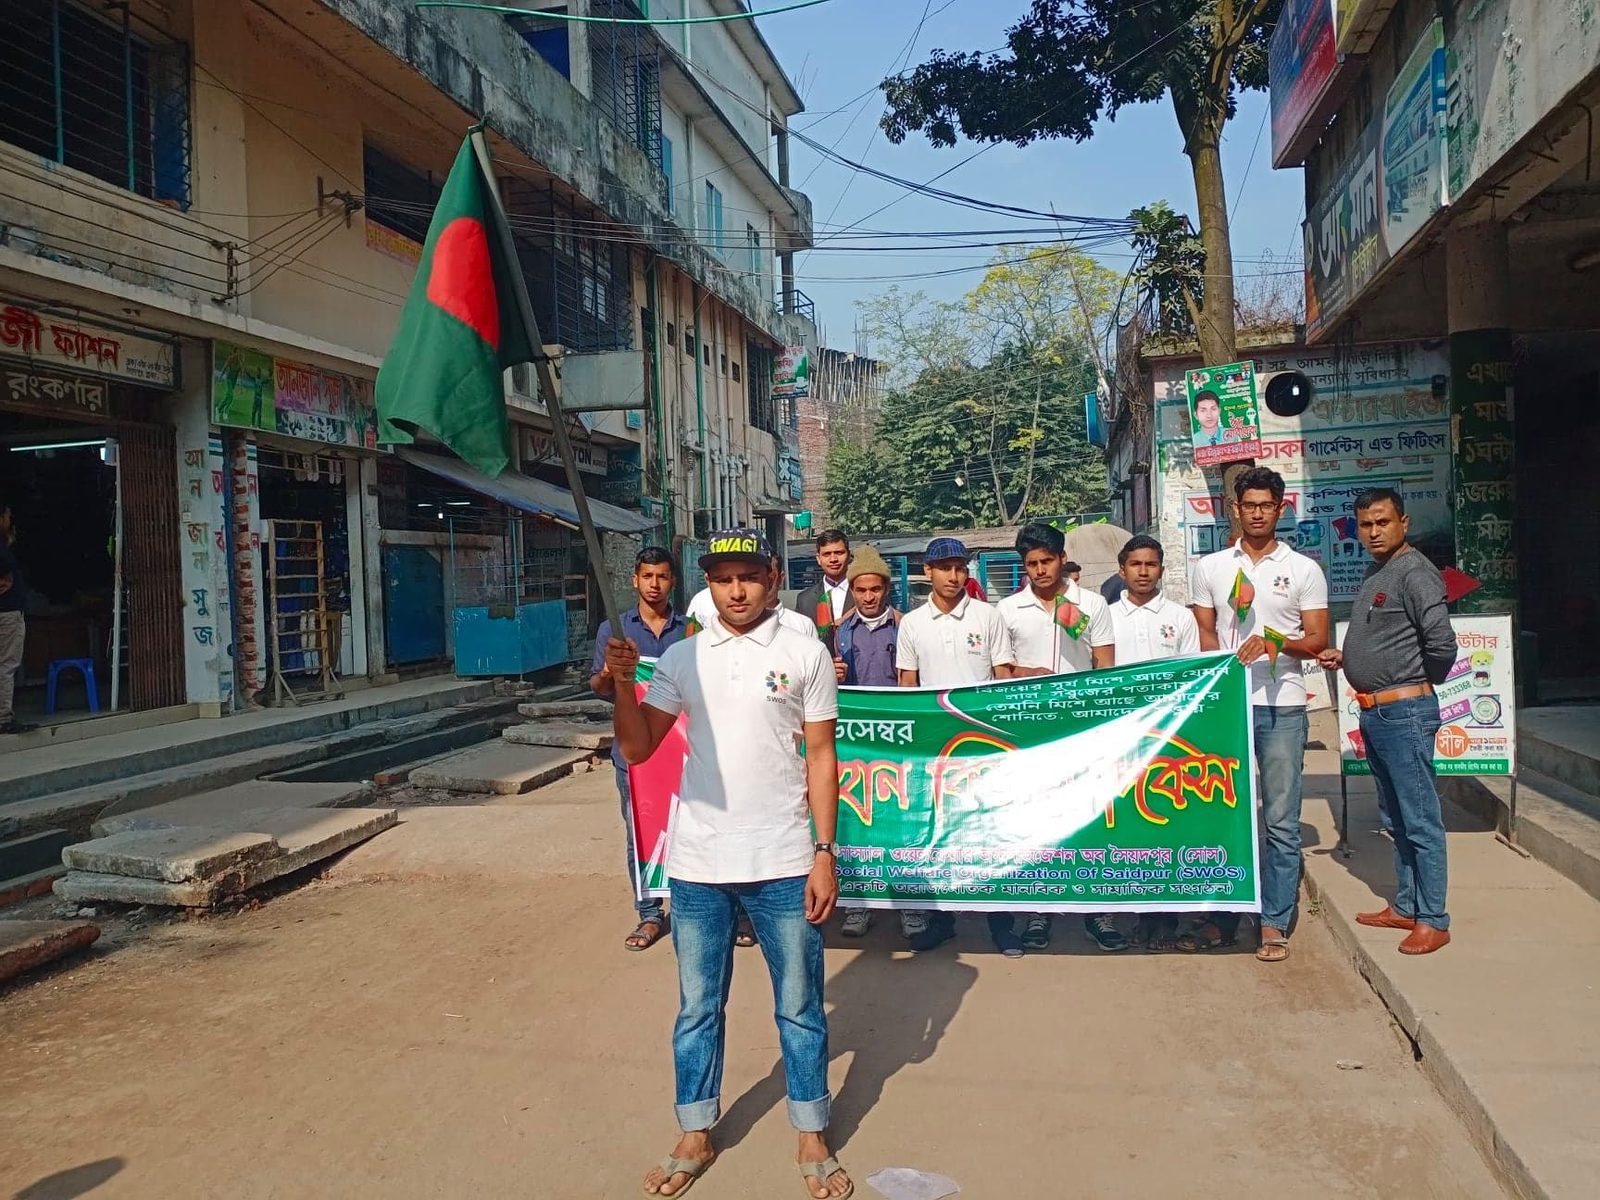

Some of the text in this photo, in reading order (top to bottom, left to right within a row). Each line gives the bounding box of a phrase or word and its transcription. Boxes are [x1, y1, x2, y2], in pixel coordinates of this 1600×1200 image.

[50, 325, 121, 371] ফ্যাশন
[1084, 675, 1124, 688] মিশে
[1131, 671, 1176, 682] আছে
[766, 695, 787, 705] SWOS
[984, 700, 1042, 712] তেমনি
[1047, 698, 1088, 710] মিশে
[1094, 696, 1137, 708] আছে
[1004, 691, 1039, 702] লাল
[1437, 727, 1466, 757] সীল
[1078, 848, 1108, 865] অব
[1108, 844, 1173, 868] সৈয়দপুর
[1177, 845, 1228, 868] (সোস)
[835, 865, 1246, 882] Social Welfare Organization Of Saidpur (SWOS)
[1001, 881, 1067, 896] মানবিক
[1071, 883, 1086, 895] ও
[1091, 881, 1166, 896] সামাজিক
[1169, 879, 1235, 896] সংগঠন)
